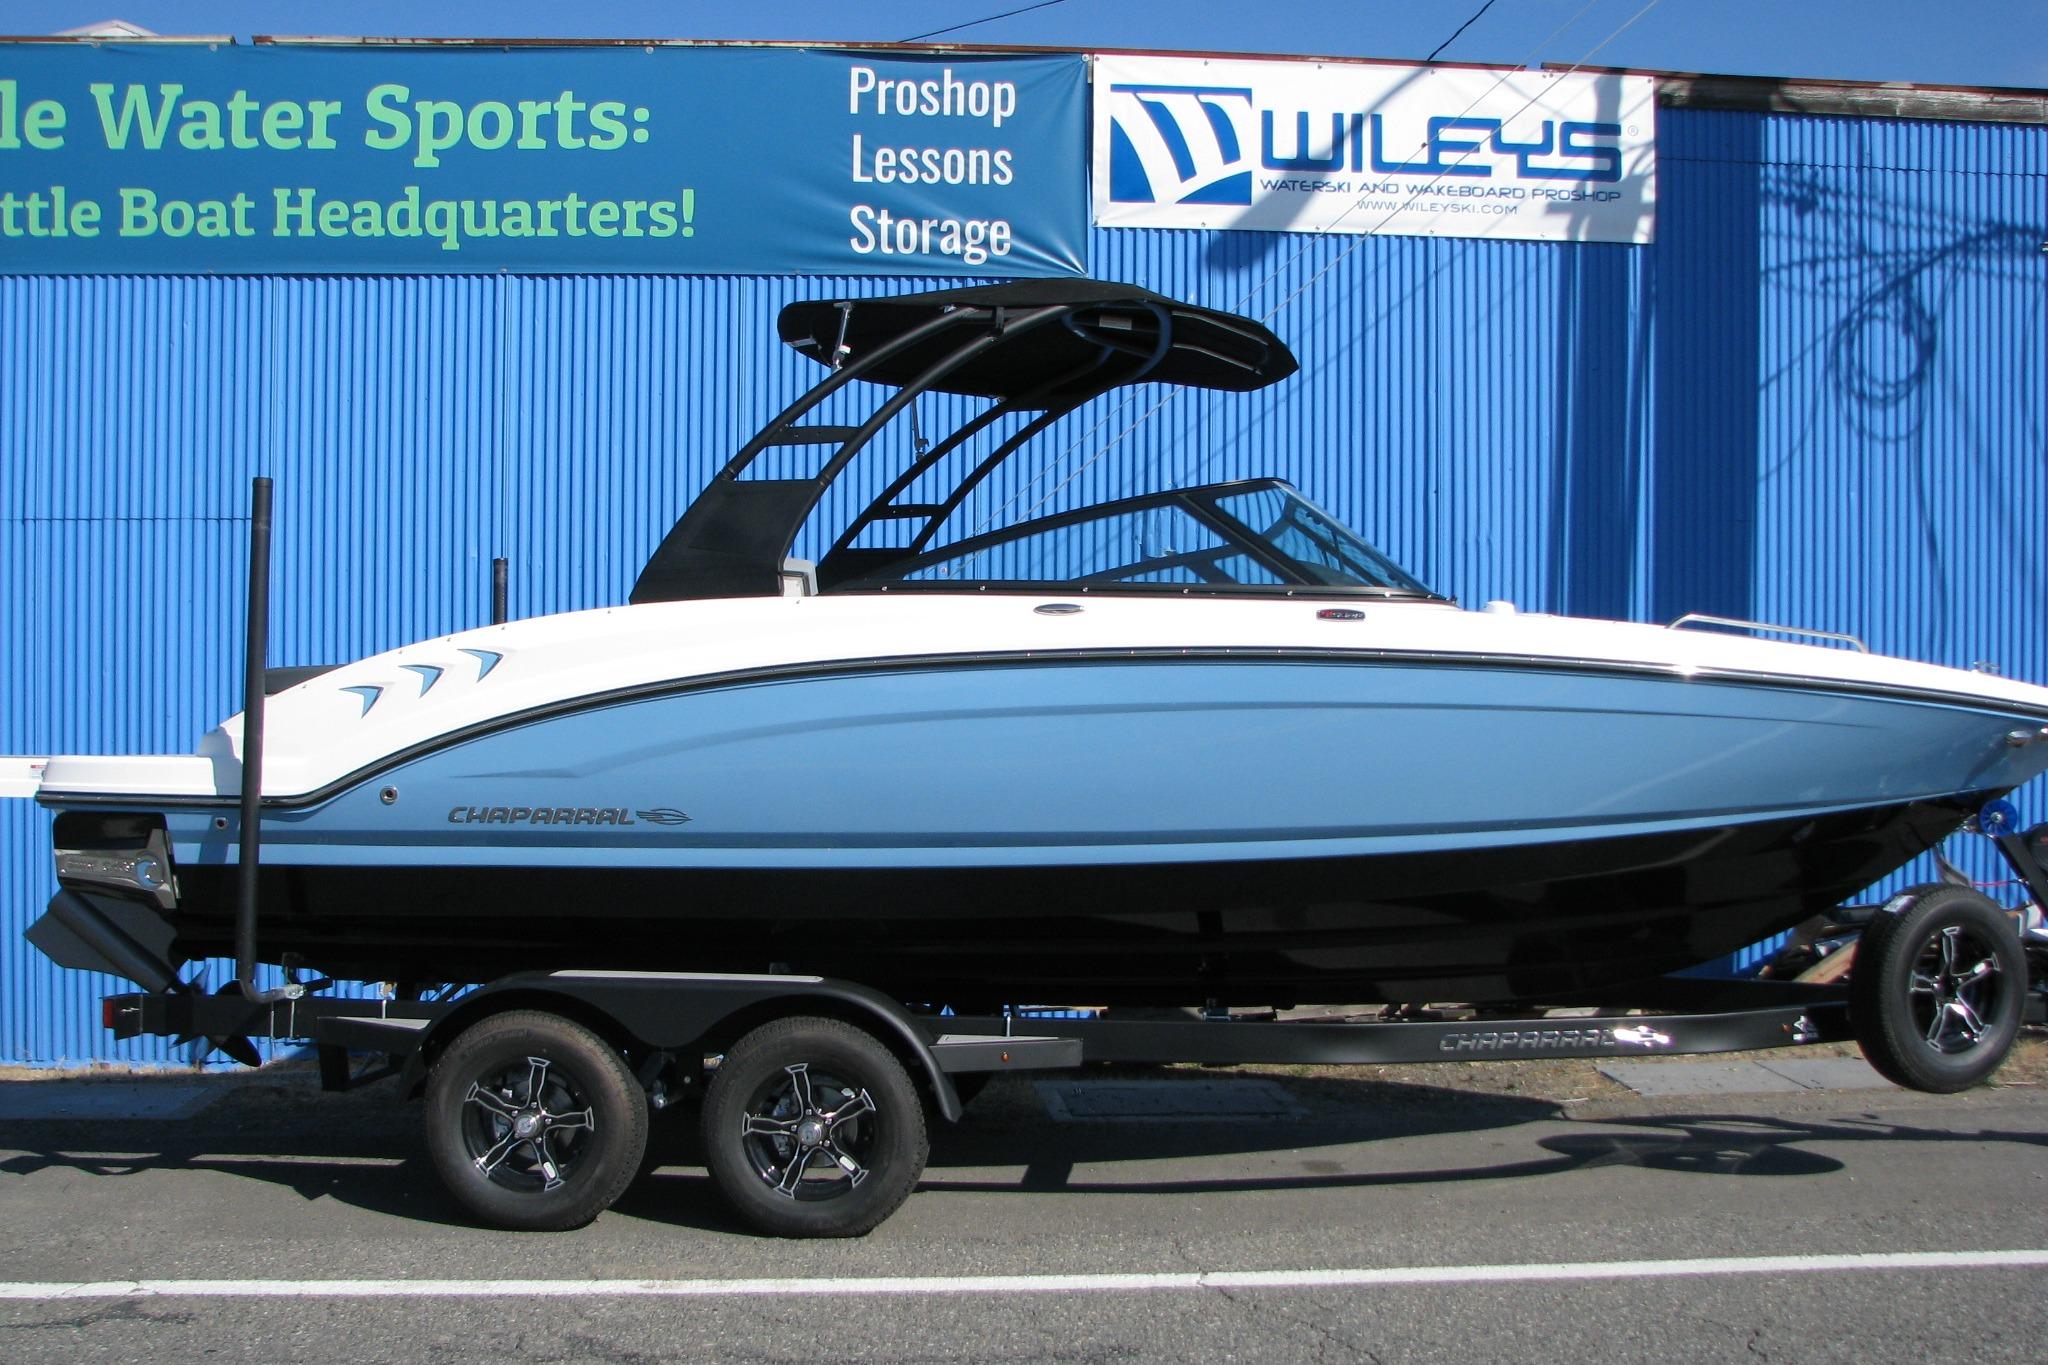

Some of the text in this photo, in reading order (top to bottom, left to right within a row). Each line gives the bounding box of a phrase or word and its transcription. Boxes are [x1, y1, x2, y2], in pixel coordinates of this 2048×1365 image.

[0, 80, 650, 168] le Water Sports:
[850, 67, 1016, 128] Proshop
[852, 134, 1013, 186] Lessons
[1261, 109, 1622, 182] WILEYS
[0, 186, 696, 250] ttle Boat Headquarters!
[1260, 179, 1621, 202] WATERSKI AND WAKEBOARD PROSHOP
[1357, 200, 1518, 215] WWWWILEYSKI.COM
[850, 205, 1011, 266] Storage
[448, 806, 635, 825] CHAPARRAL
[1439, 1029, 1616, 1051] CHAPARRAL
